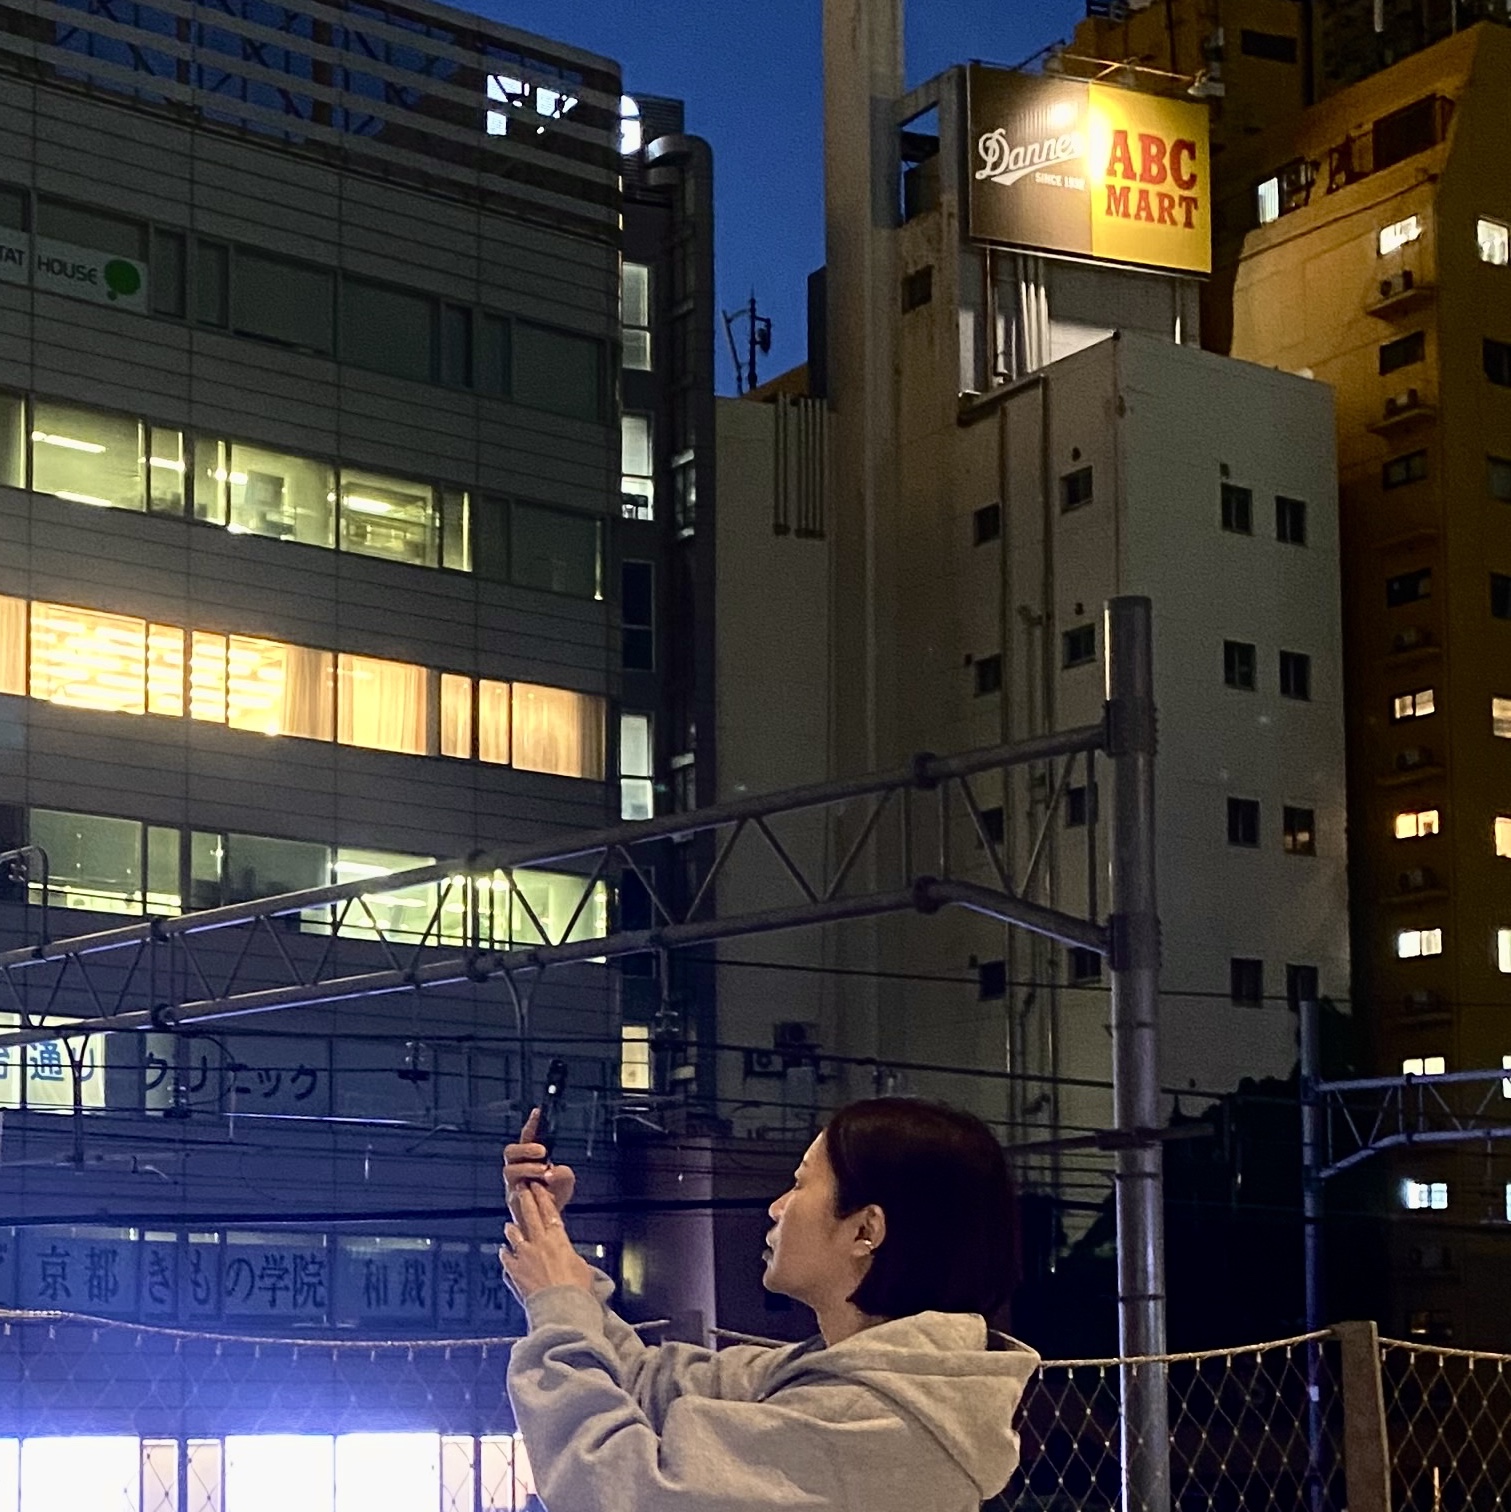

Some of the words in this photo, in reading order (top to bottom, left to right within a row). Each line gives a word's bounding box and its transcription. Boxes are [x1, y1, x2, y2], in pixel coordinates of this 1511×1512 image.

[975, 127, 1086, 181] Danne
[1105, 129, 1197, 191] ABC
[1104, 184, 1199, 229] MART
[37, 254, 98, 285] HOUSE
